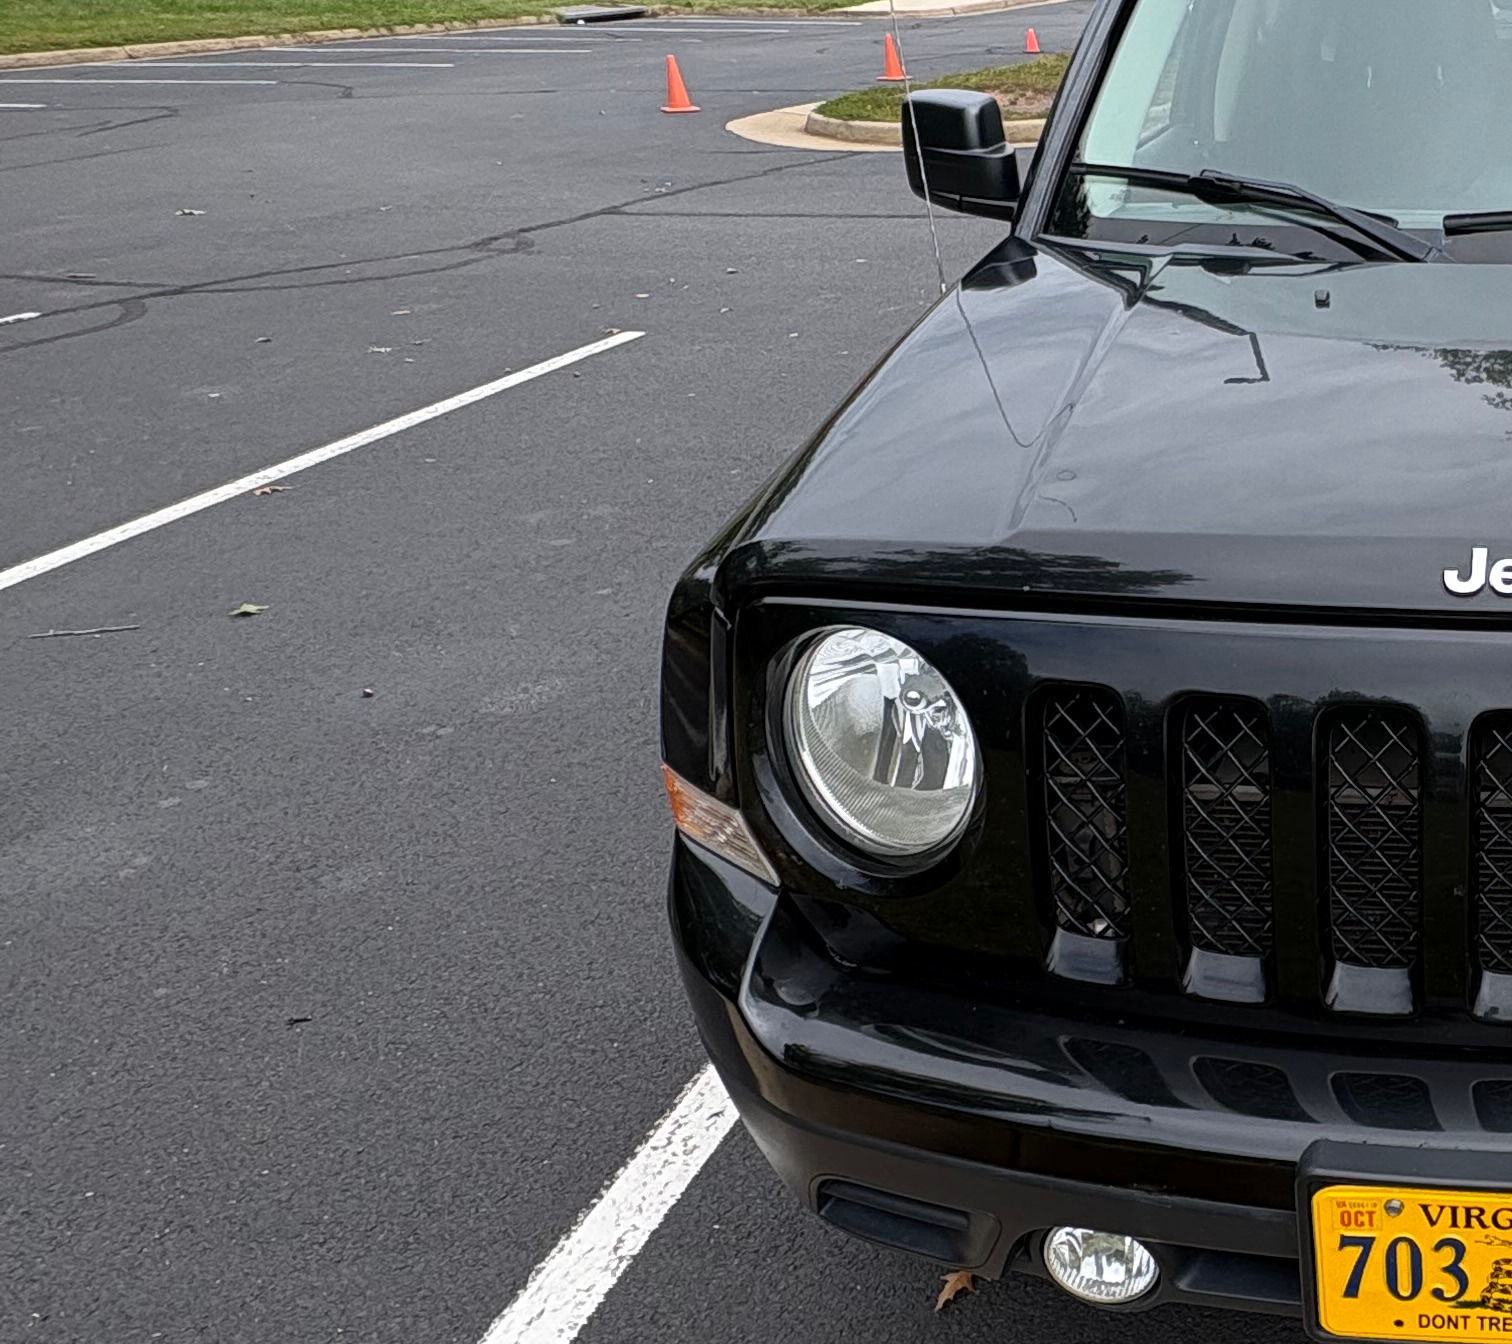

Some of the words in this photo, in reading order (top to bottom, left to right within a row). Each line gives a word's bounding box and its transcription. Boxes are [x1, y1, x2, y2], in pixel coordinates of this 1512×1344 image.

[1340, 1210, 1376, 1228] OCT
[1338, 1234, 1470, 1303] 703
[1418, 1313, 1471, 1331] DONT
